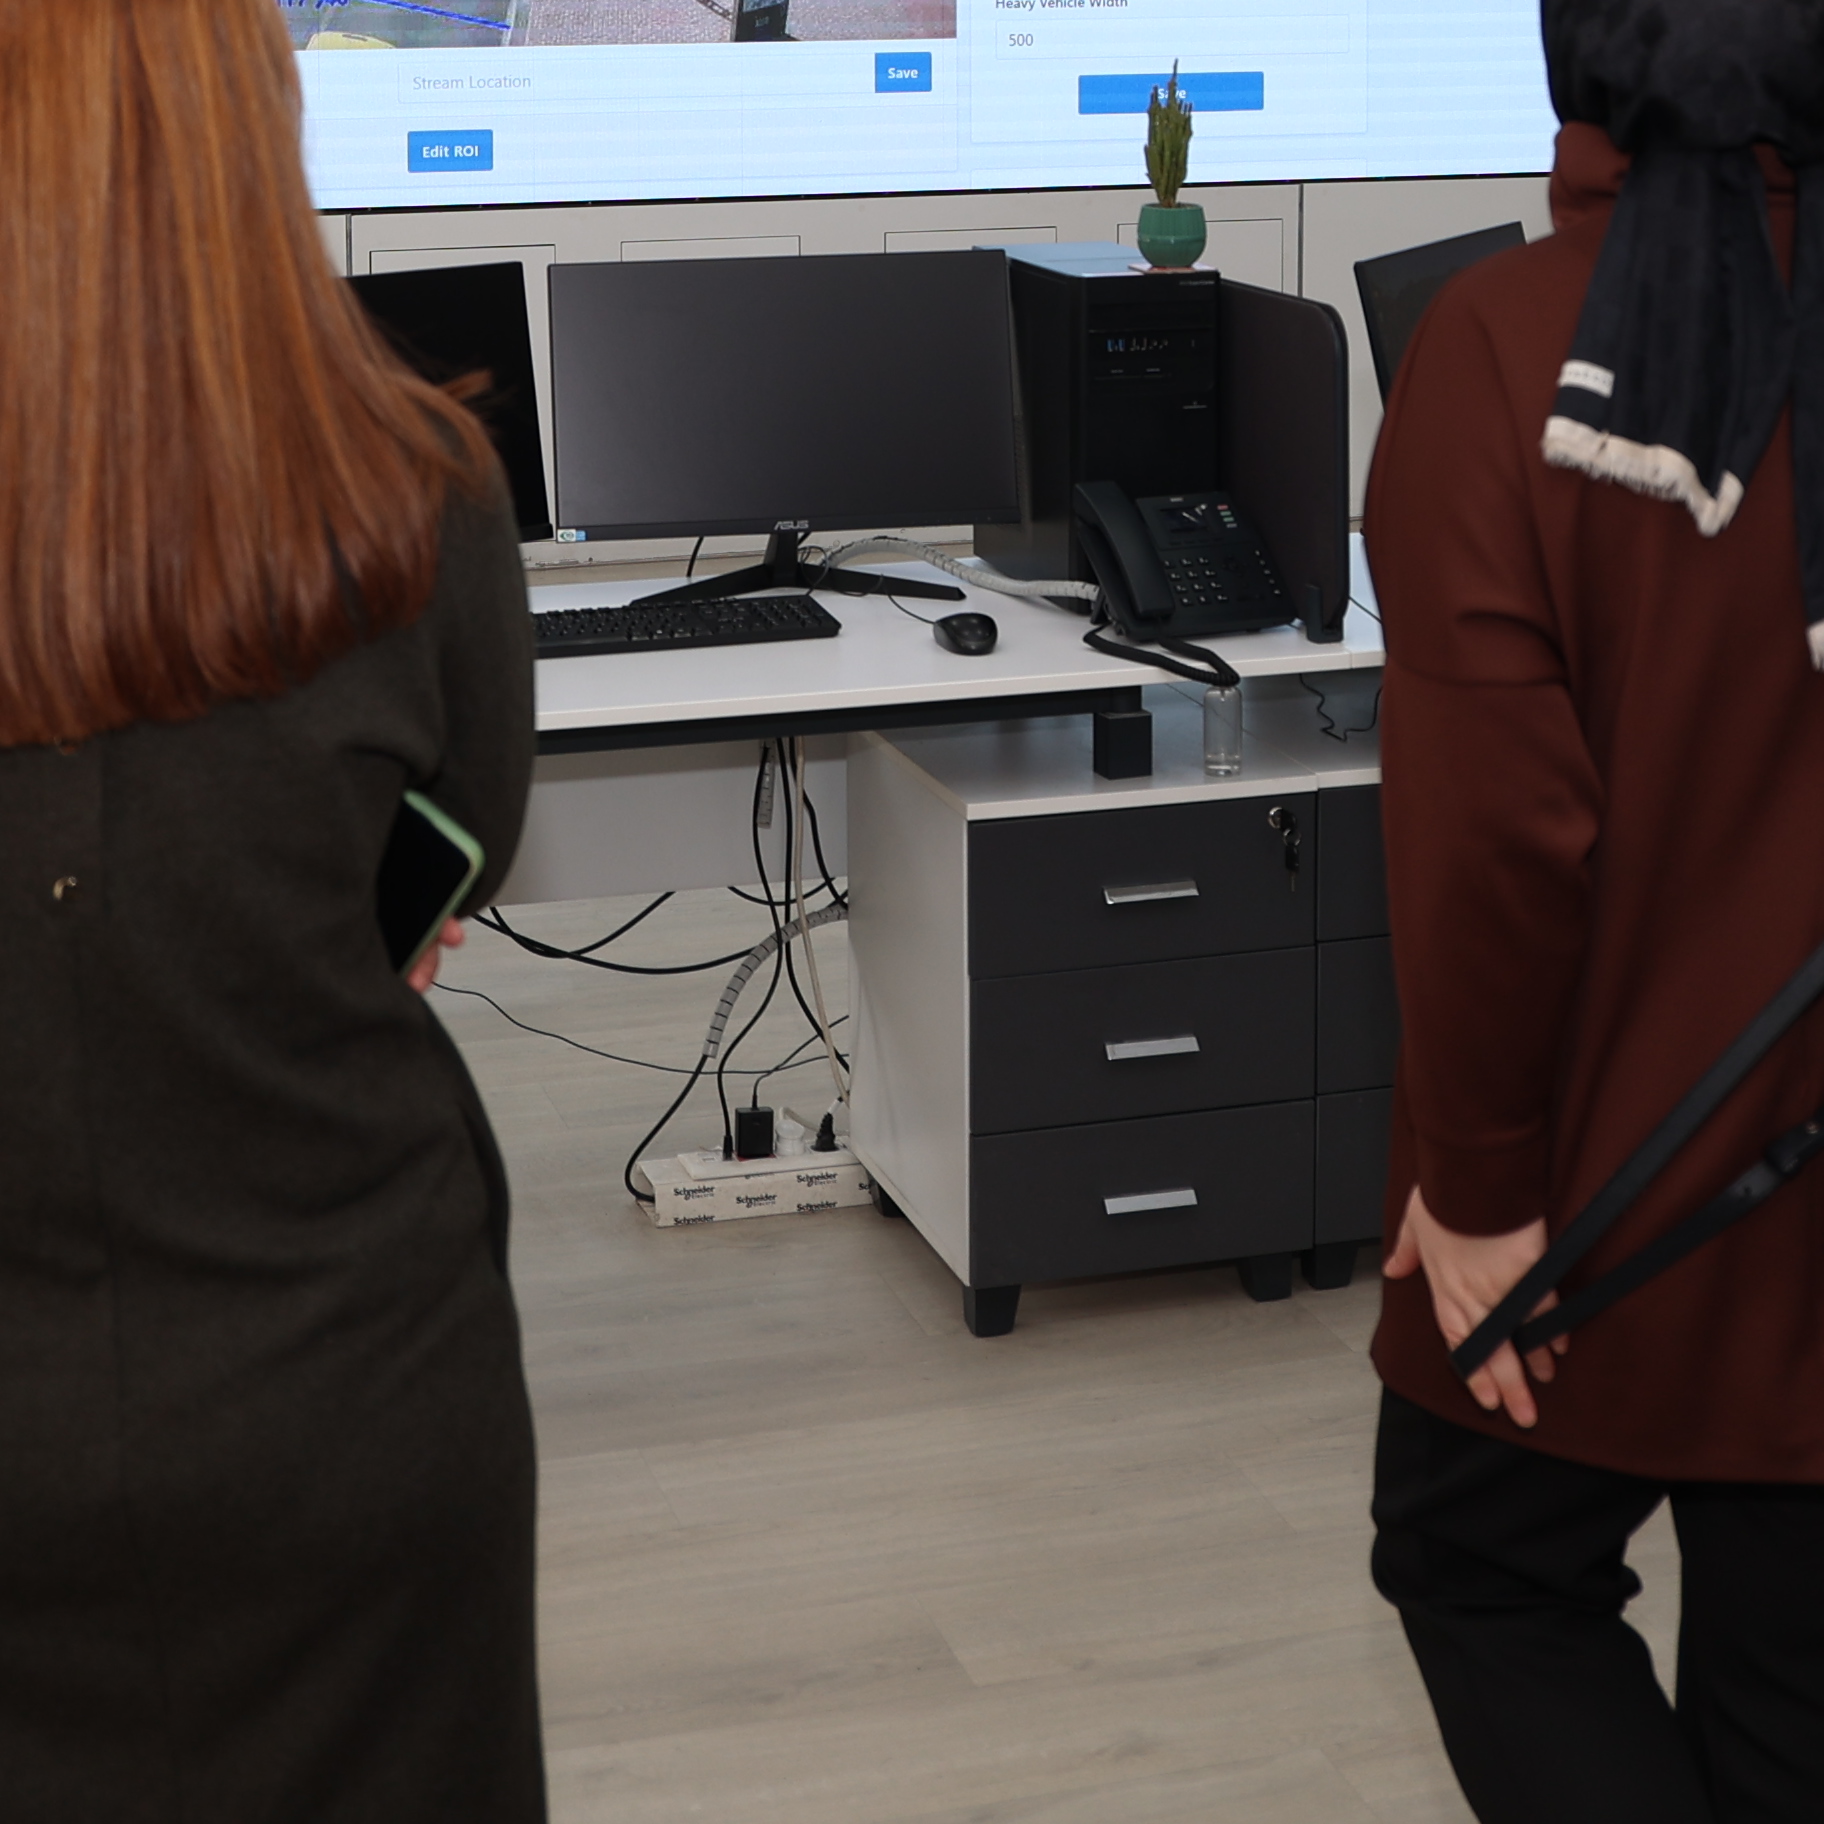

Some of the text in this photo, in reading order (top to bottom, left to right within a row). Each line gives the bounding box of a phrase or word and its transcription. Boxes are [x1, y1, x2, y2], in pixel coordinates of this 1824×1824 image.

[1008, 33, 1034, 47] 500
[887, 67, 919, 80] Save
[412, 75, 531, 90] Stream Location
[422, 145, 479, 158] Edit ROI
[774, 520, 809, 530] ASUS
[797, 1172, 838, 1187] Schneider
[674, 1185, 716, 1201] Schneider
[736, 1193, 778, 1208] Schneider
